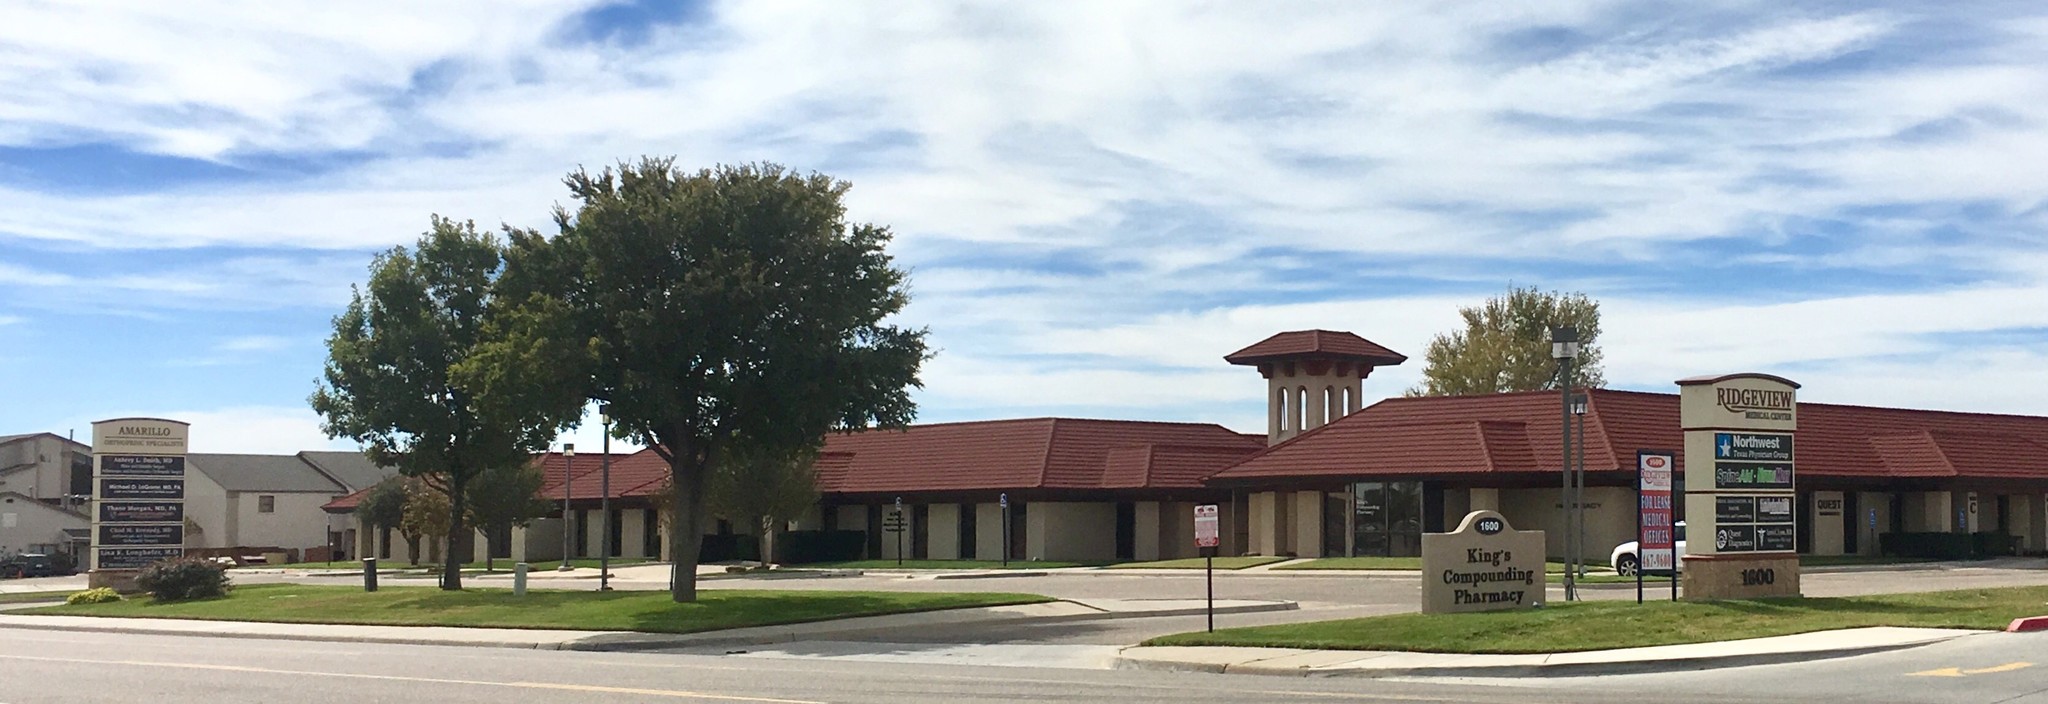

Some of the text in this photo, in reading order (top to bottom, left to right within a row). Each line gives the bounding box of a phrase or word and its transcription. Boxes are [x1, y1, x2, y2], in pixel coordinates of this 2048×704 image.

[1717, 388, 1792, 410] RIDGEVIEW
[1745, 411, 1769, 419] MEDICAL
[119, 427, 171, 436] AMARILLO
[146, 440, 184, 448] SPECIALISTS
[1733, 435, 1780, 448] Northwest
[1748, 450, 1773, 459] Physician
[1773, 451, 1789, 459] Group
[1641, 496, 1671, 509] FOR LEASE
[1817, 500, 1841, 510] QUEST
[1969, 502, 1977, 514] C
[1480, 521, 1500, 531] 1600
[1642, 513, 1670, 526] MEDICAL
[1643, 529, 1669, 543] OFFICES
[1728, 529, 1742, 539] Quest
[1728, 540, 1753, 548] Diagnostics
[1466, 548, 1512, 567] King's
[1642, 553, 1671, 568] 467-9600
[1443, 567, 1534, 588] Compounding
[1741, 568, 1775, 586] 1600
[1454, 589, 1525, 605] Pharmacy
